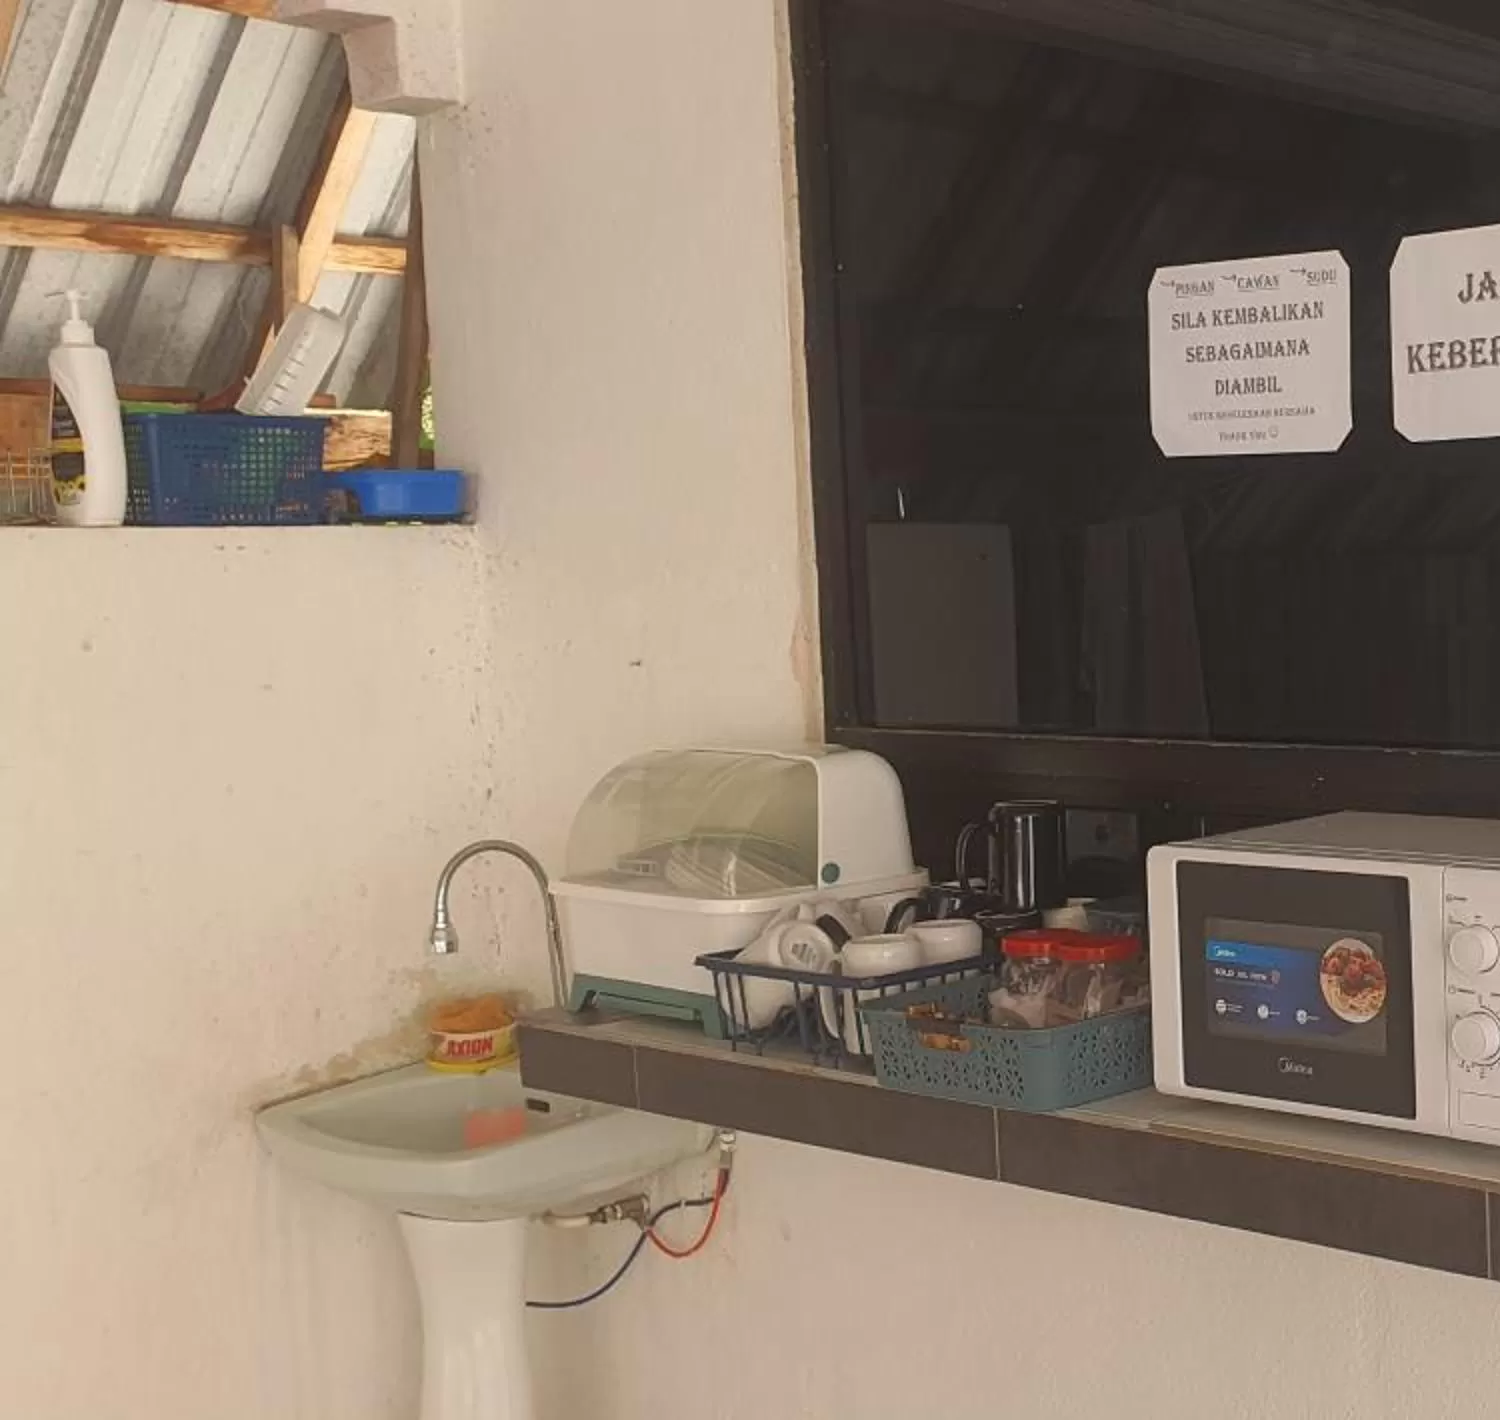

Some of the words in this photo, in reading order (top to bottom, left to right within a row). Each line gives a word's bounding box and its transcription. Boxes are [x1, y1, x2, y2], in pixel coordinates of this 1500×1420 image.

[1237, 274, 1280, 291] CAWAN
[1171, 311, 1207, 331] SILA
[1212, 301, 1324, 327] KEMBALIKAN
[1185, 339, 1310, 363] SEBAGAIMANA
[1215, 375, 1283, 396] DIAMBIL
[447, 1038, 493, 1056] AXION
